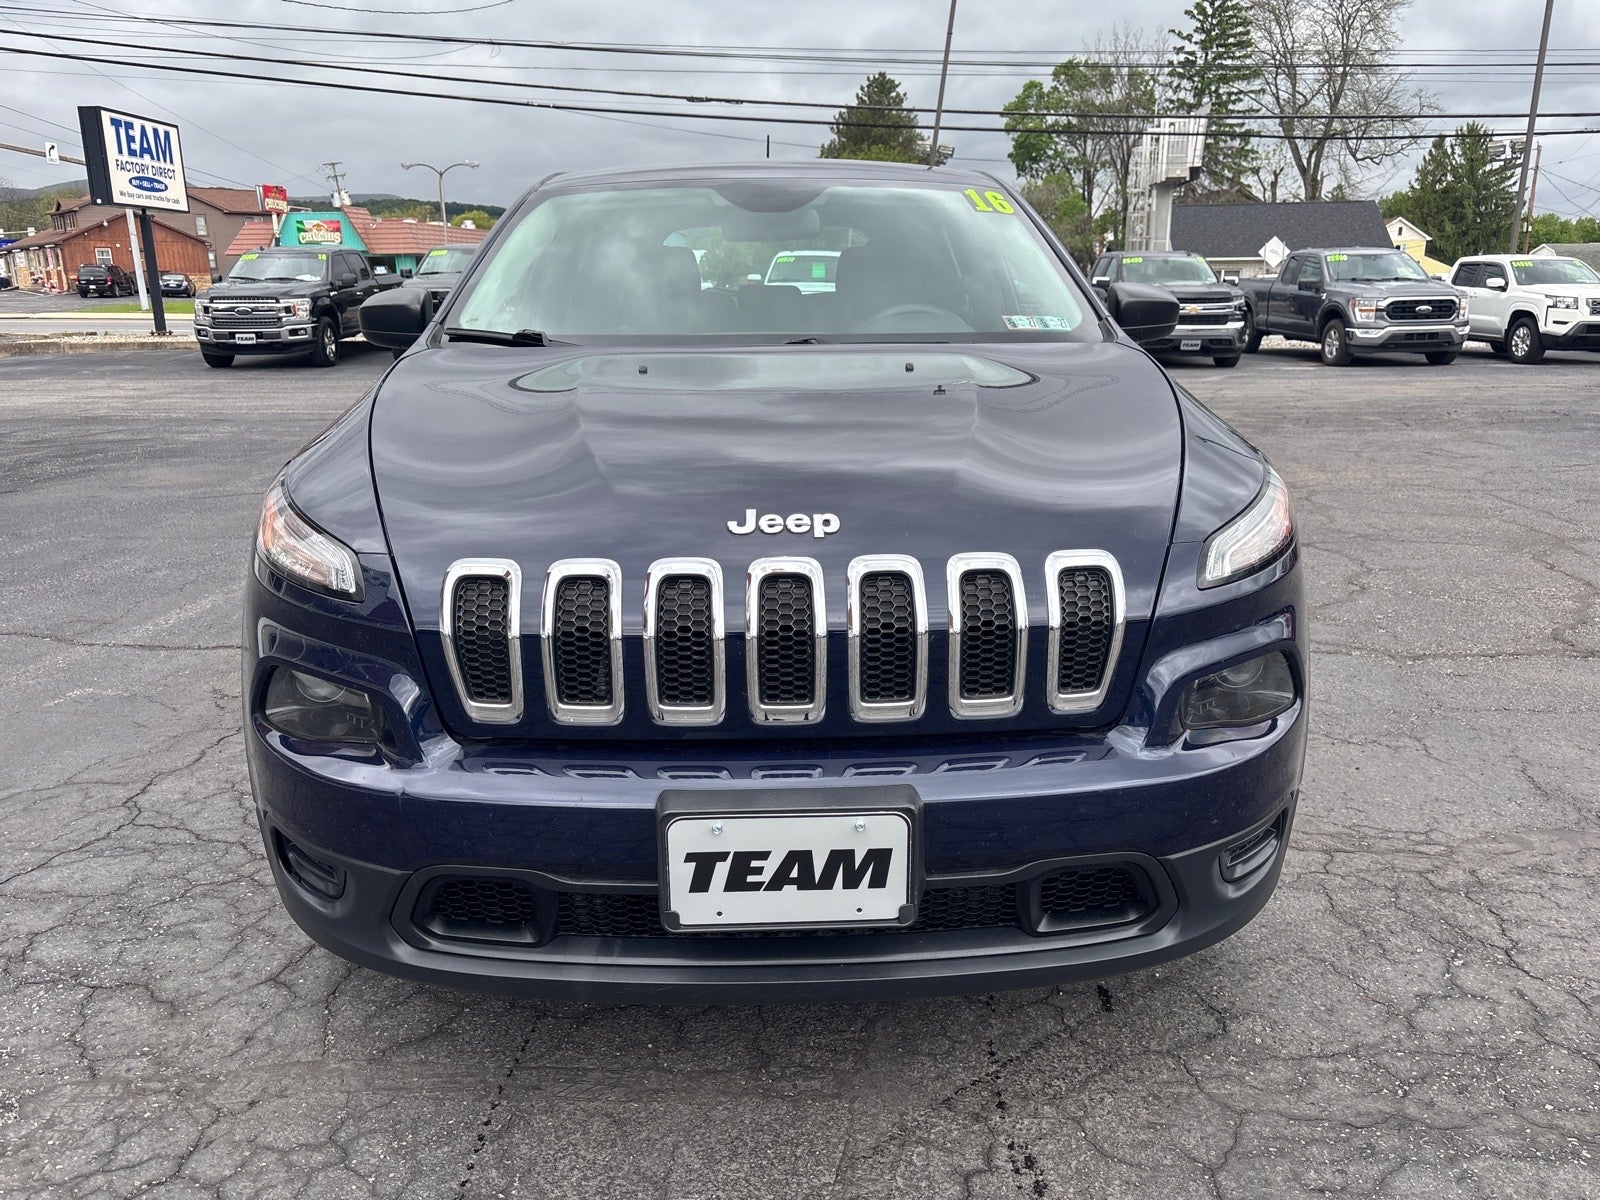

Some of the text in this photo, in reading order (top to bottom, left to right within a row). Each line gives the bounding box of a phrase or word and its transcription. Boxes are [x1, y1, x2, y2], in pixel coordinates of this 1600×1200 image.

[109, 117, 174, 165] TEAM
[115, 159, 176, 180] FACTORY DIRECT
[127, 191, 135, 200] buy
[171, 197, 181, 205] cash
[963, 189, 1015, 214] 16
[299, 231, 342, 244] CHUCHIS
[727, 508, 840, 539] Jeep
[683, 848, 894, 893] TEAM
